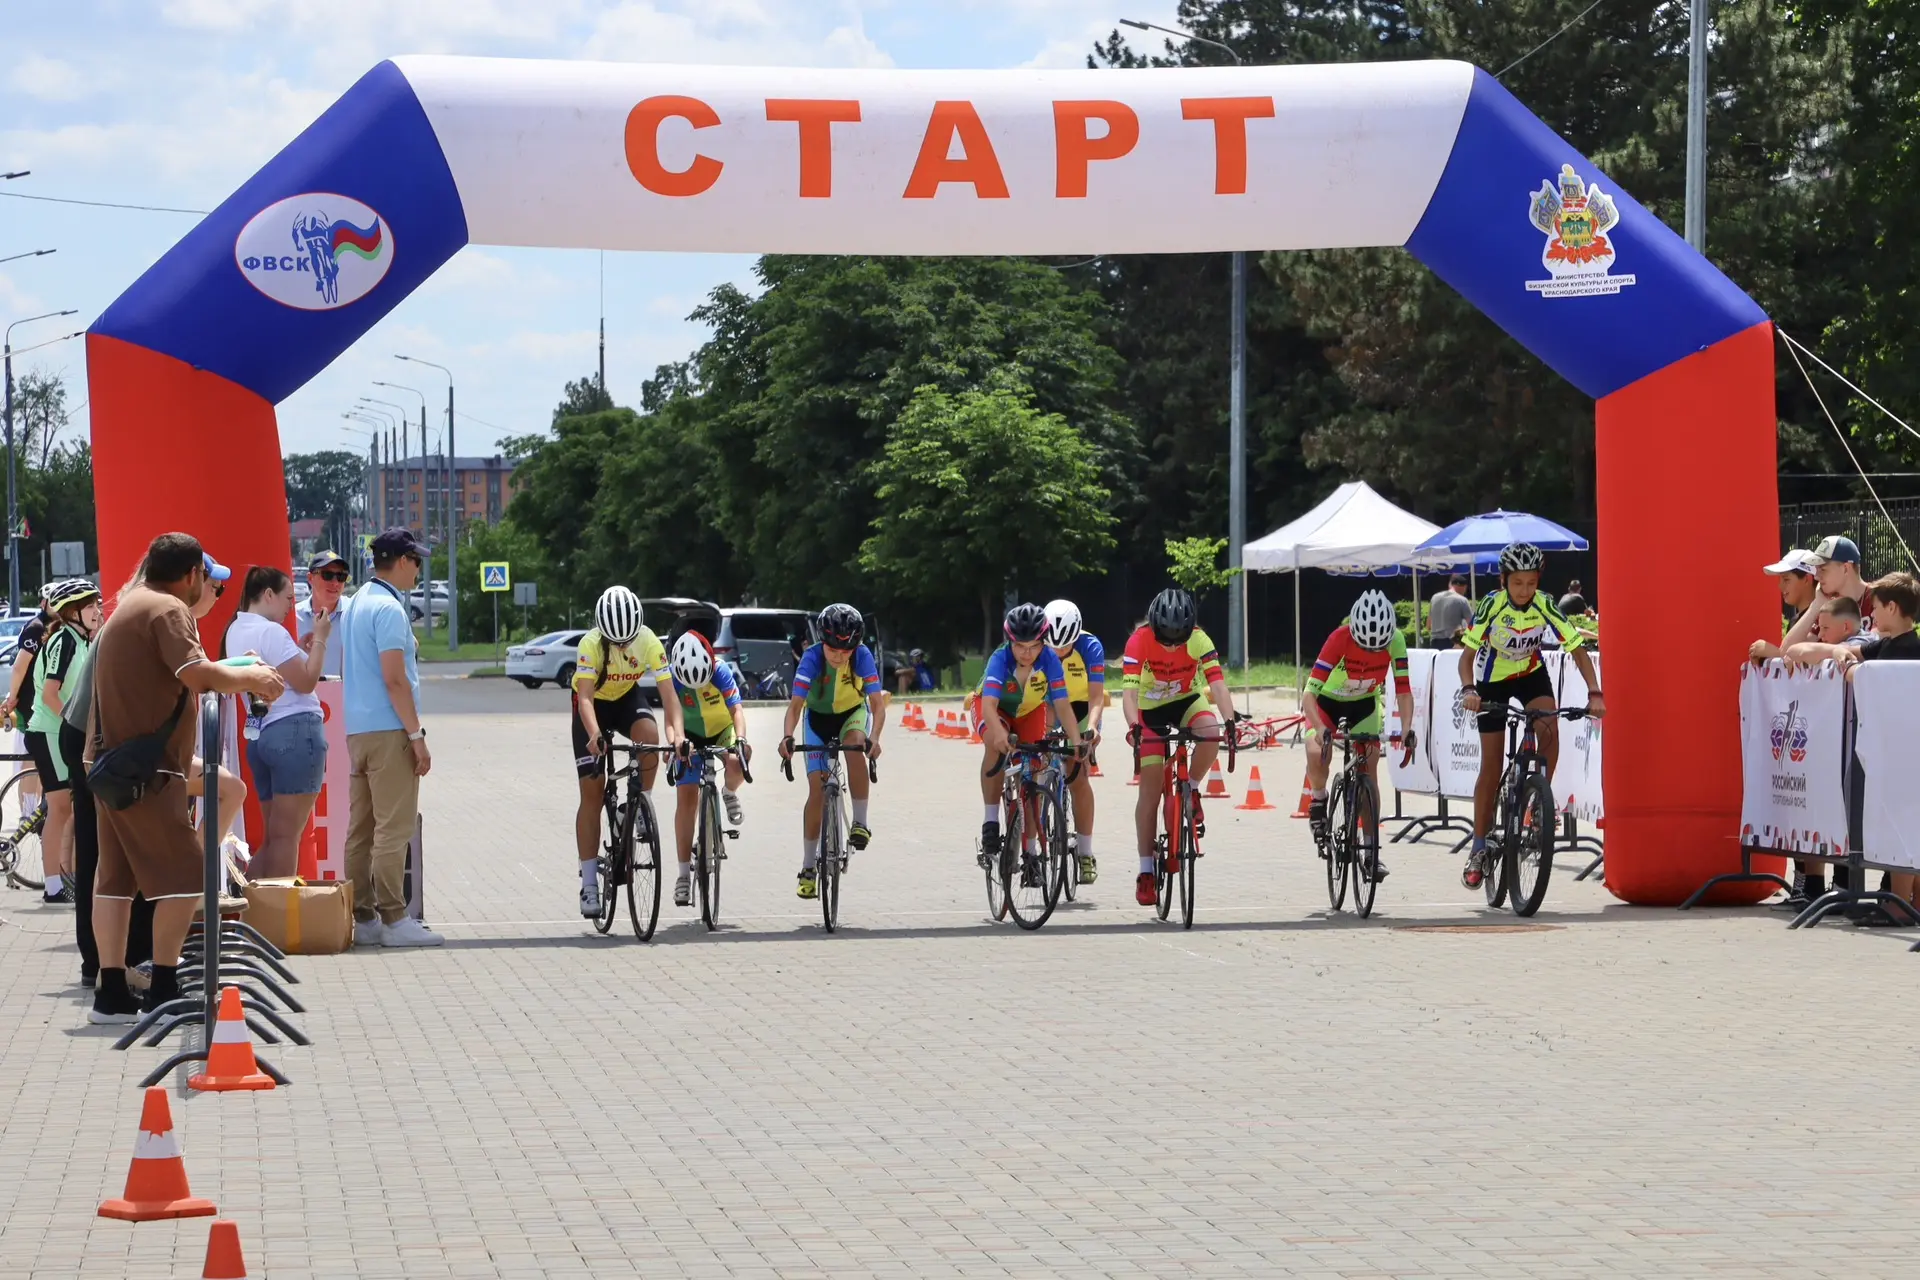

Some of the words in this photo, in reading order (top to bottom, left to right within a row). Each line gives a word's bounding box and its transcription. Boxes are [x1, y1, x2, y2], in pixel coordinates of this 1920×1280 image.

[623, 94, 1275, 199] СТАРТ
[243, 256, 310, 272] ФВСК
[1528, 281, 1569, 289] ФИЗИЧЕСКОЙ
[1570, 279, 1602, 287] КУЛЬТУРЫ
[1555, 272, 1605, 280] МИНИСТЕРСТВО
[1544, 288, 1601, 296] КРАСНОДАРСКОГО
[1772, 772, 1806, 792] РОССИЙСКИЙ
[12, 807, 42, 841] PINAR
